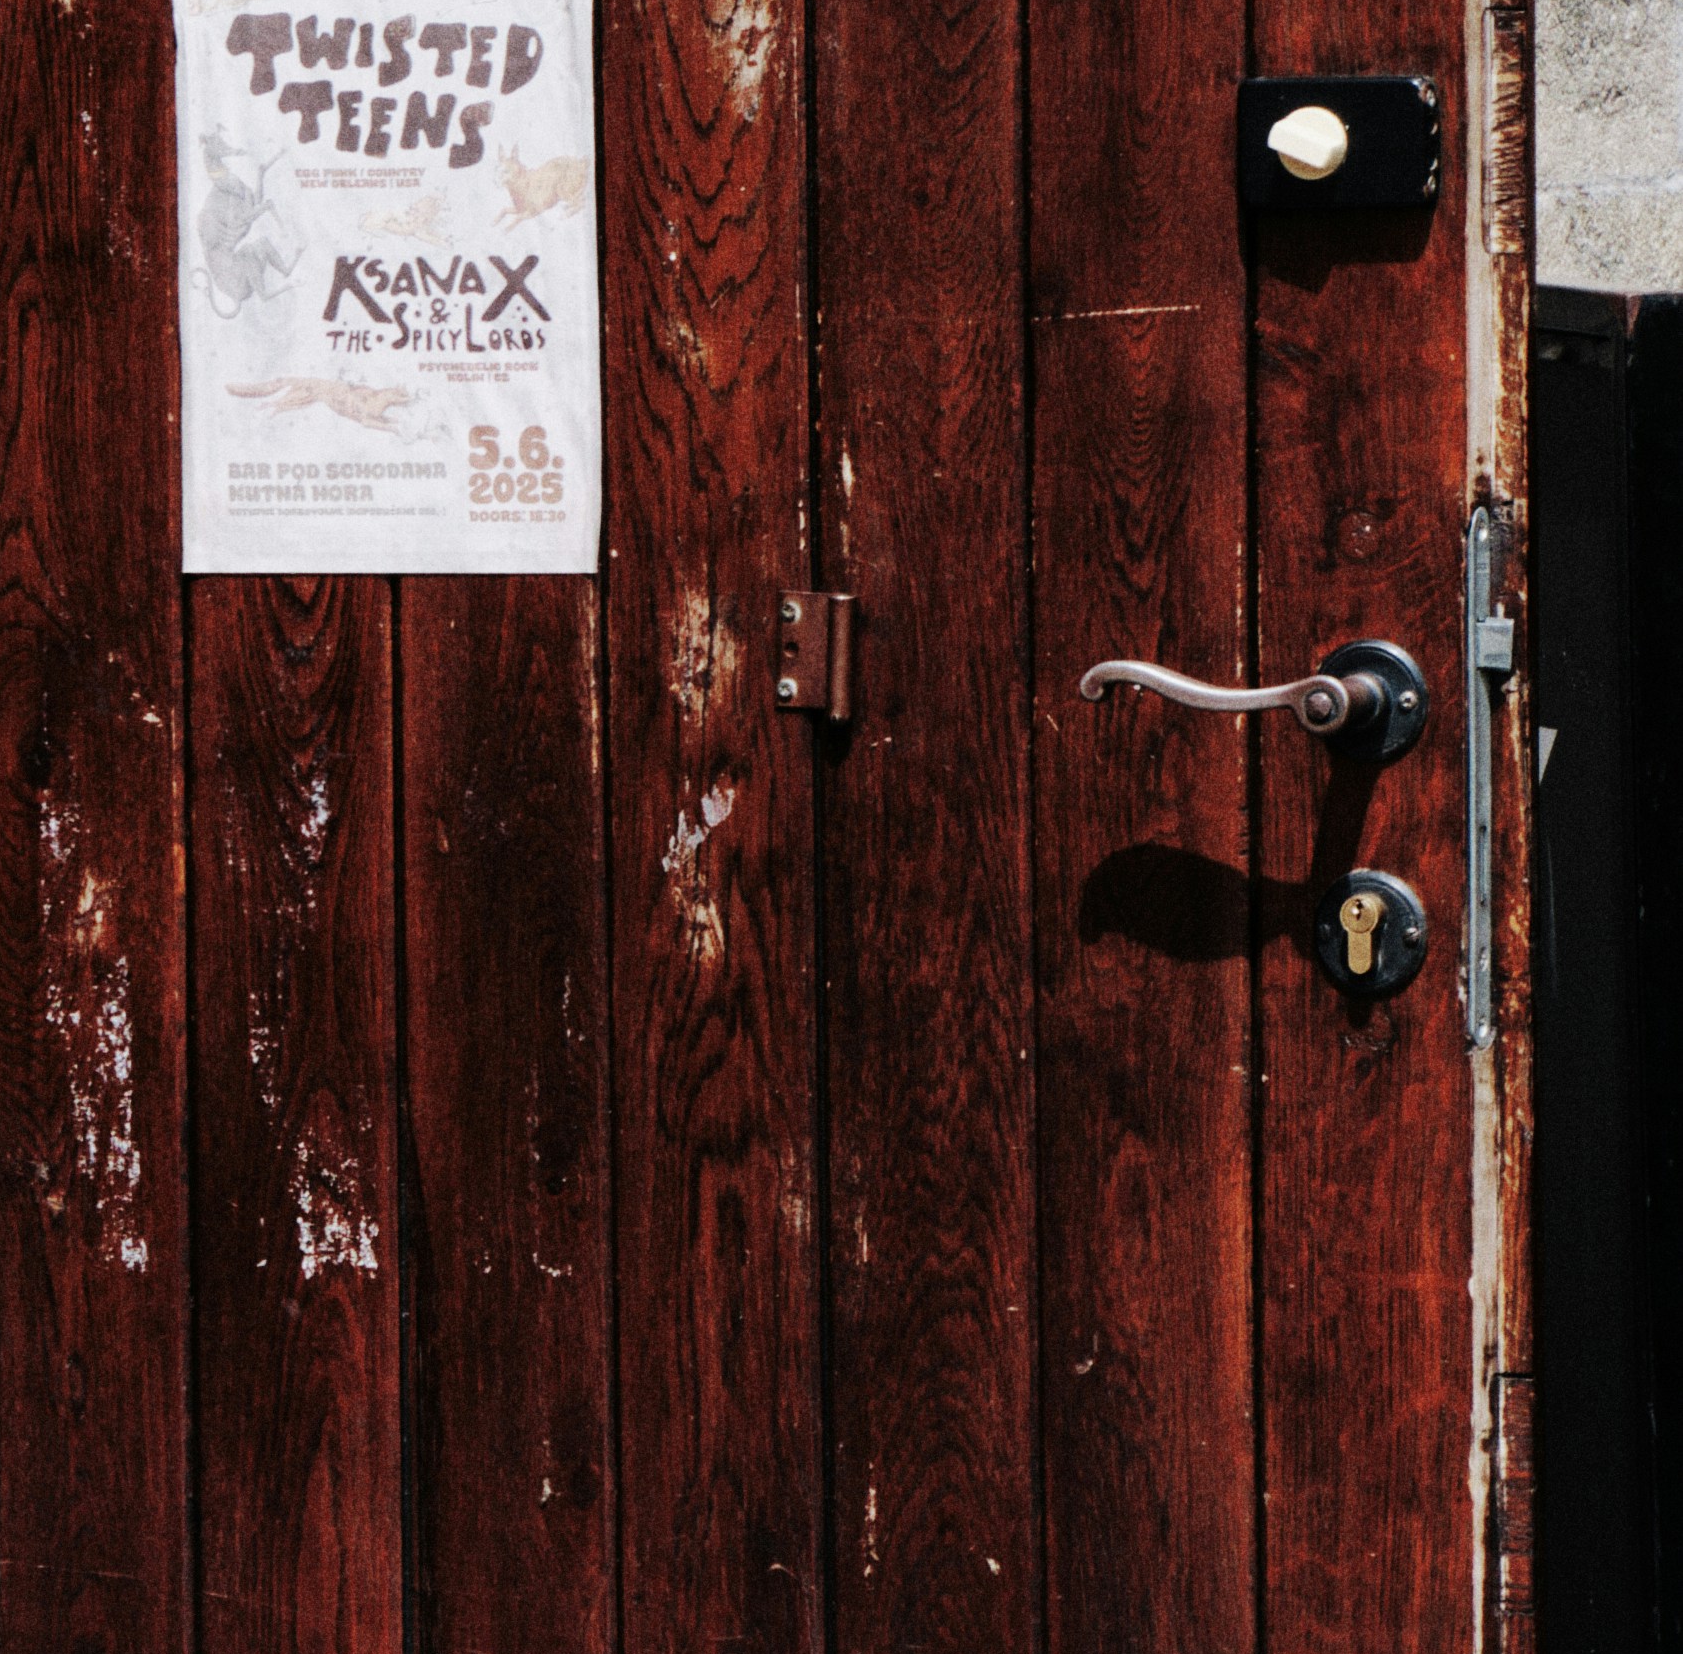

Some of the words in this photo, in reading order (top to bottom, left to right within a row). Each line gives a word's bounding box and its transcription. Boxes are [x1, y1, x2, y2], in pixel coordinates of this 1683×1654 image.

[226, 12, 544, 96] TWISTED
[278, 80, 494, 169] TEENS
[322, 254, 552, 324] KSANAX
[429, 298, 451, 324] &
[326, 329, 372, 353] THE
[468, 424, 566, 470] 5.6.
[228, 462, 272, 480] BAR
[277, 462, 320, 482] POD
[326, 461, 447, 480] SCHODAMA
[311, 484, 374, 502] HORA
[468, 472, 565, 505] 2025
